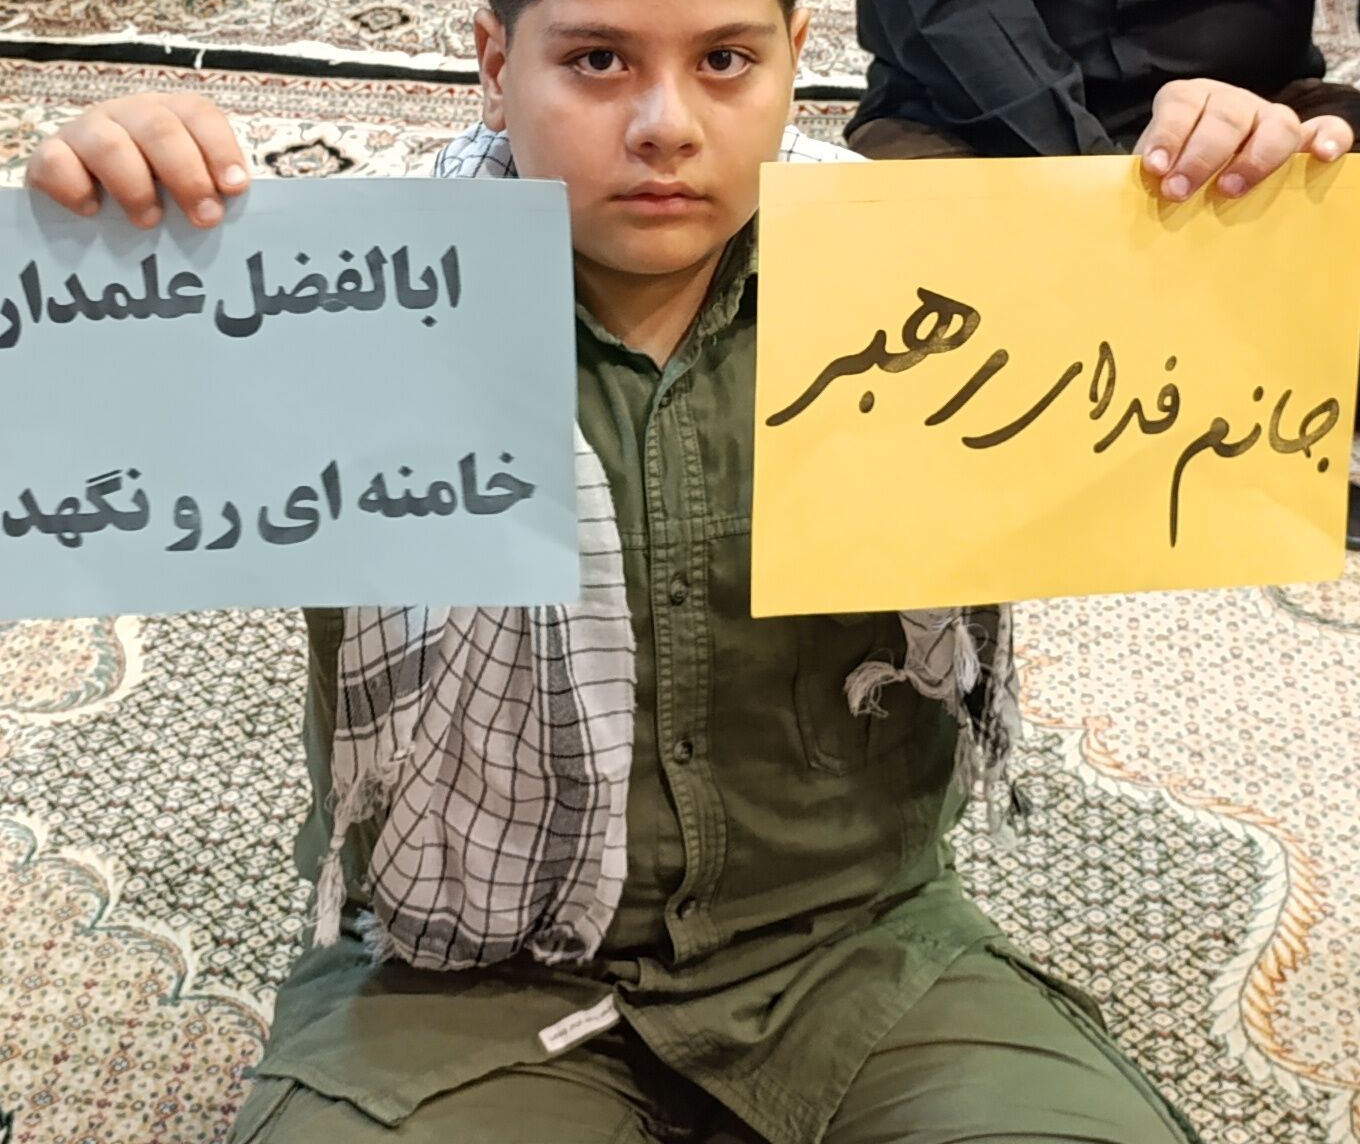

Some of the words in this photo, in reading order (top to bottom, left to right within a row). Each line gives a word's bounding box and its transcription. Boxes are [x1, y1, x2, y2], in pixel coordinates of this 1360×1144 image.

[213, 244, 463, 339] ابالفضل
[764, 286, 1011, 429] رهبر
[960, 340, 1182, 455] فدای
[257, 459, 344, 546] ای
[357, 451, 538, 519] خامنه
[1168, 385, 1342, 549] جانم
[165, 493, 243, 553] رو
